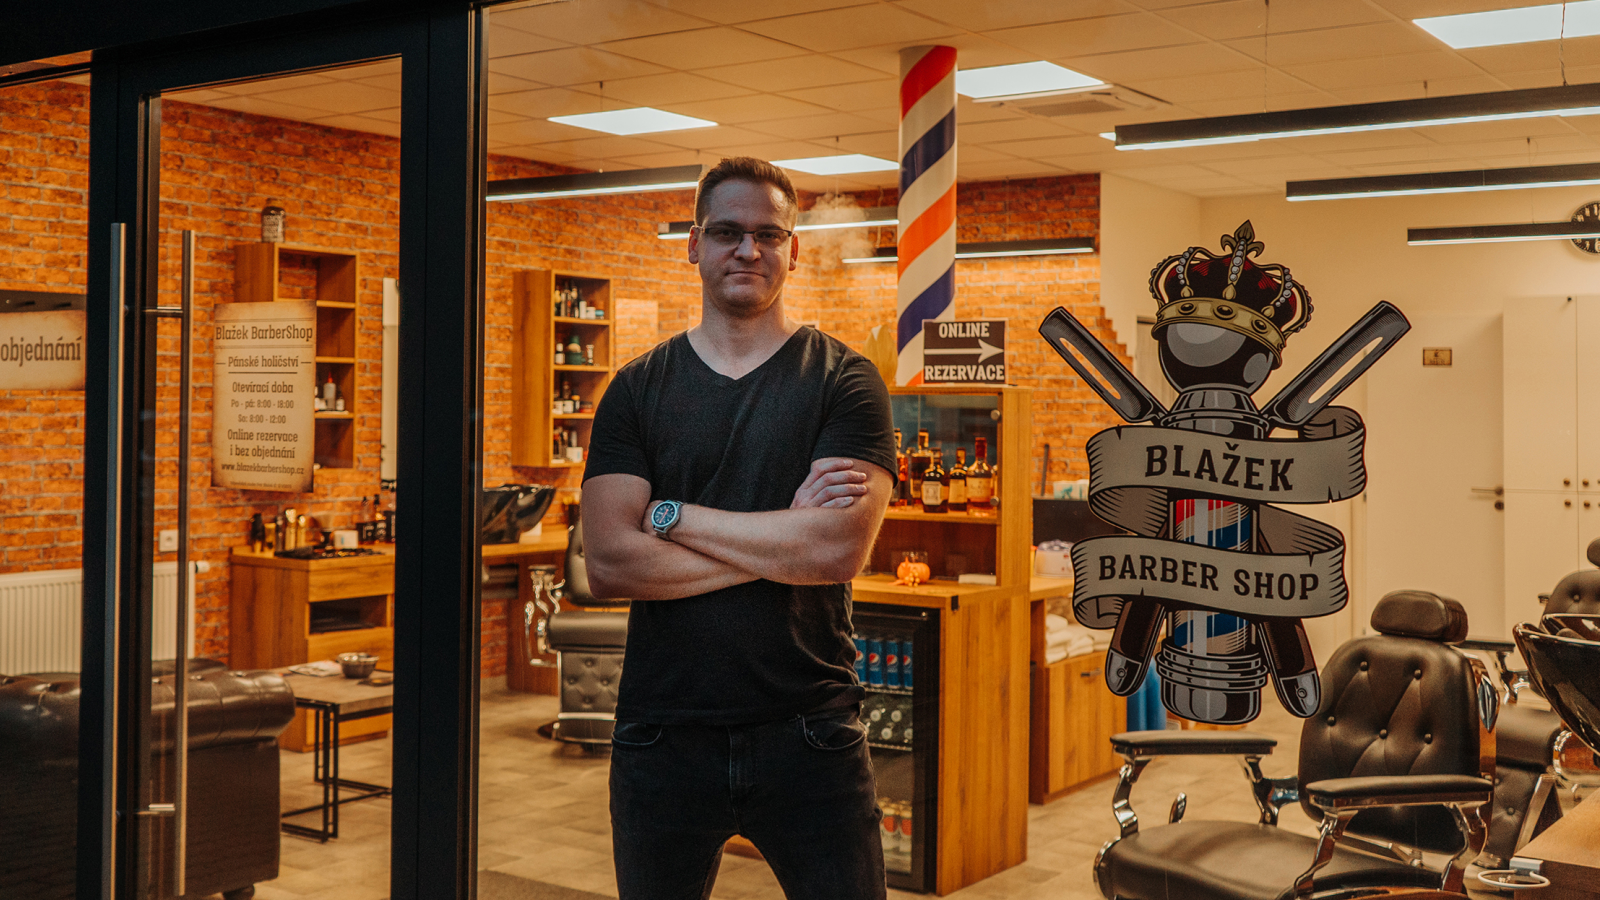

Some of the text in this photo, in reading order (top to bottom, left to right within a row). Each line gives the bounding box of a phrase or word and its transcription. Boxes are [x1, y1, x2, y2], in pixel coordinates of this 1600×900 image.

[216, 324, 313, 342] Blažek BarberShop
[939, 322, 990, 338] ONLINE
[0, 336, 82, 367] objednání
[228, 355, 299, 367] Pánské holičství
[924, 364, 1005, 380] REZERVACE
[232, 381, 294, 393] Otevírací doba
[231, 399, 239, 408] Po
[257, 399, 271, 409] 8:00
[277, 400, 294, 409] 18:00
[249, 414, 264, 423] 8:00
[269, 415, 286, 424] 12:00
[227, 429, 298, 442] Online rezervace
[235, 444, 250, 457] bez
[251, 445, 296, 460] objednání
[221, 462, 305, 476] www.blazekbarbershop.cz
[1145, 441, 1294, 492] BLAŽEK
[1098, 554, 1319, 601] BARBER SHOP
